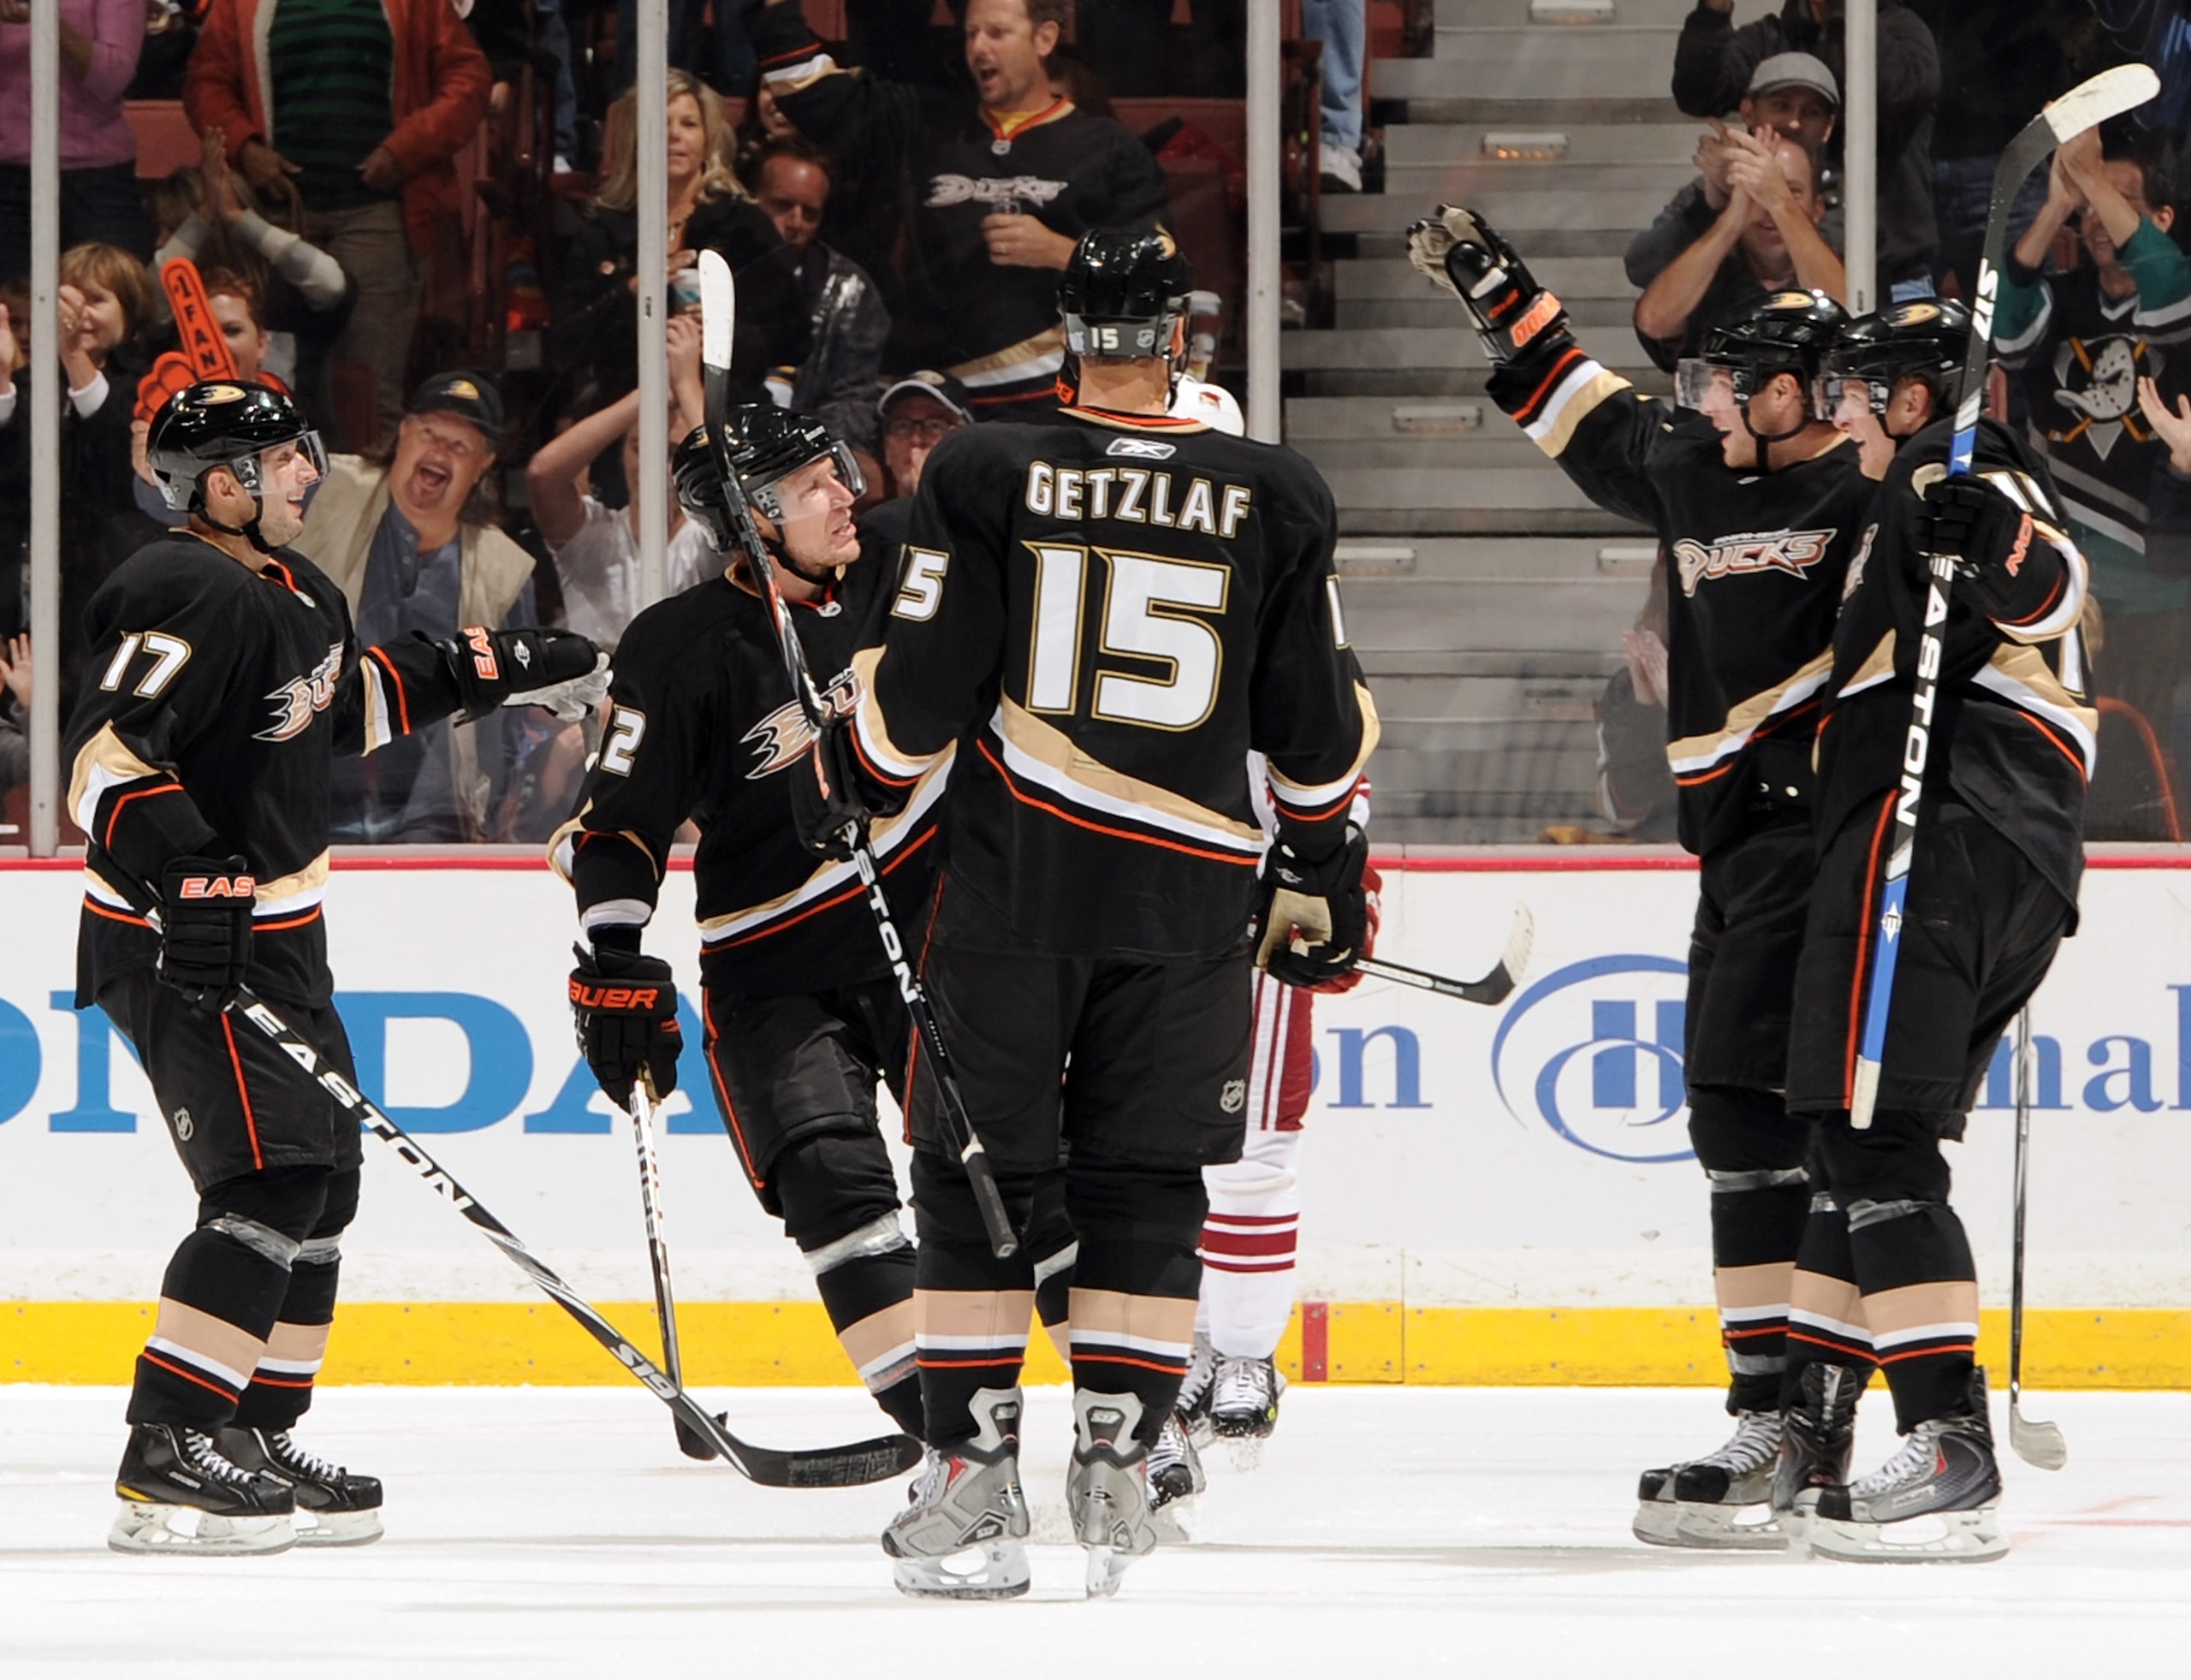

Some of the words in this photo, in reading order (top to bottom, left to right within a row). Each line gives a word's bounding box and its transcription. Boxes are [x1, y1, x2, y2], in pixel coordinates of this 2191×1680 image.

[1090, 327, 1119, 349] 15
[1025, 460, 1251, 538] GETZLAF
[98, 630, 193, 699] 17
[1020, 540, 1232, 732] 15
[245, 1002, 474, 1211] EASTON
